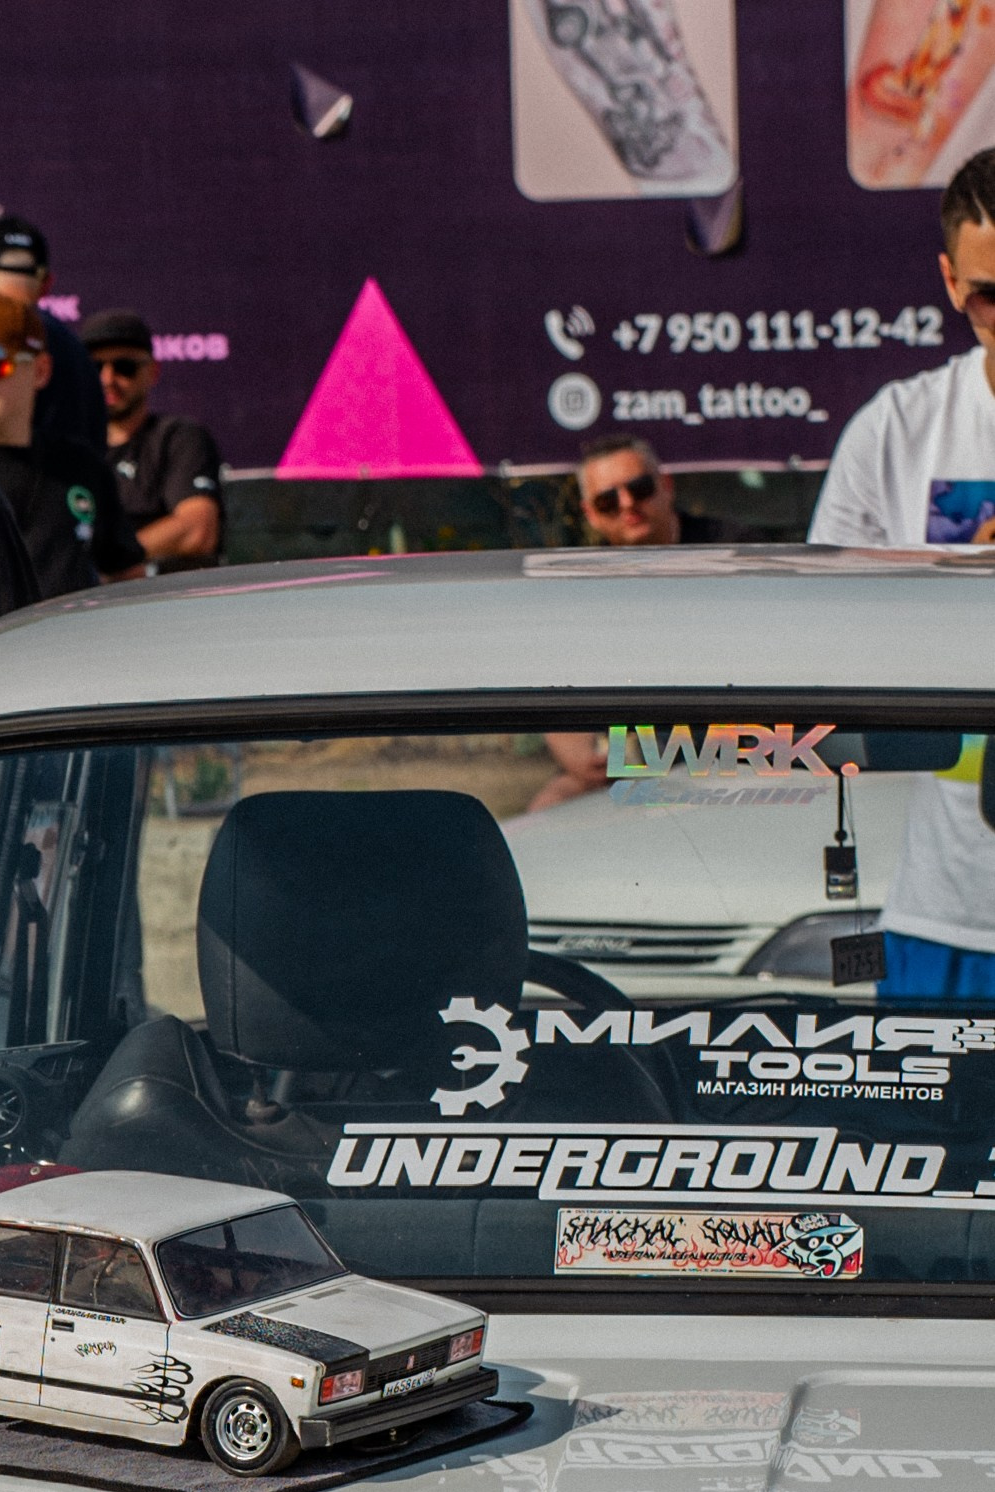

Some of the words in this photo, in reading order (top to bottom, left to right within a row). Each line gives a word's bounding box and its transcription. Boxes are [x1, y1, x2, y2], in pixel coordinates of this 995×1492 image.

[666, 311, 742, 353] 950
[746, 305, 944, 351] 111-12-42
[612, 382, 829, 425] zam_tattoo_
[699, 1050, 951, 1084] TOOLS
[696, 1081, 785, 1097] МАГАЗИН
[790, 1084, 944, 1101] ИНСТРУМЕНТОВ
